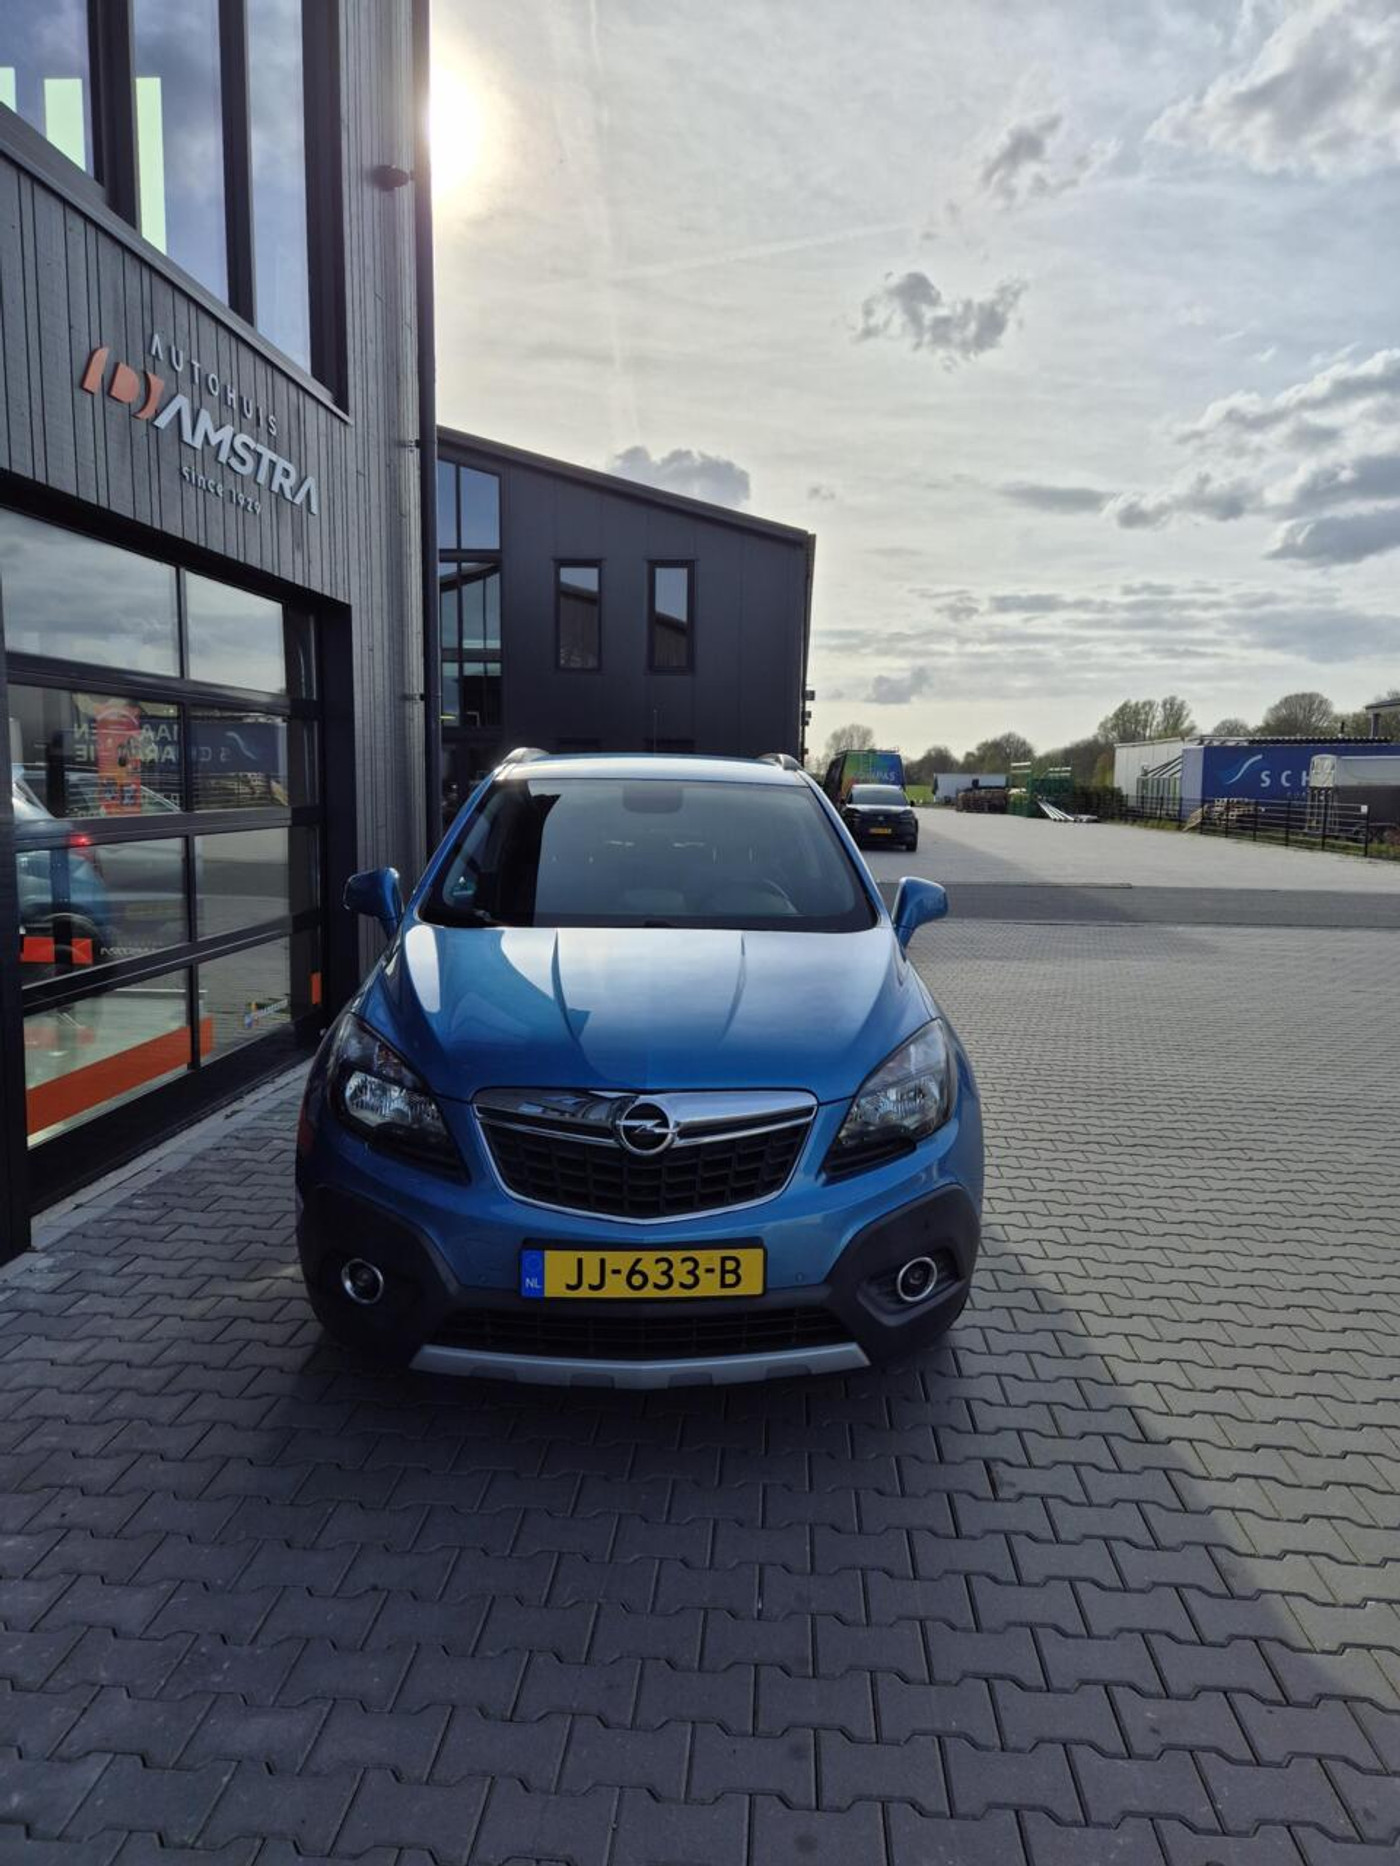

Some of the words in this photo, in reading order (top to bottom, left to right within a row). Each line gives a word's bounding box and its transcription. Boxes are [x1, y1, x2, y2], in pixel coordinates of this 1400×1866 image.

[151, 333, 278, 437] AUTOHUIS
[182, 466, 224, 498] since
[525, 1277, 542, 1289] NL
[565, 1256, 743, 1292] JJ-633-B
